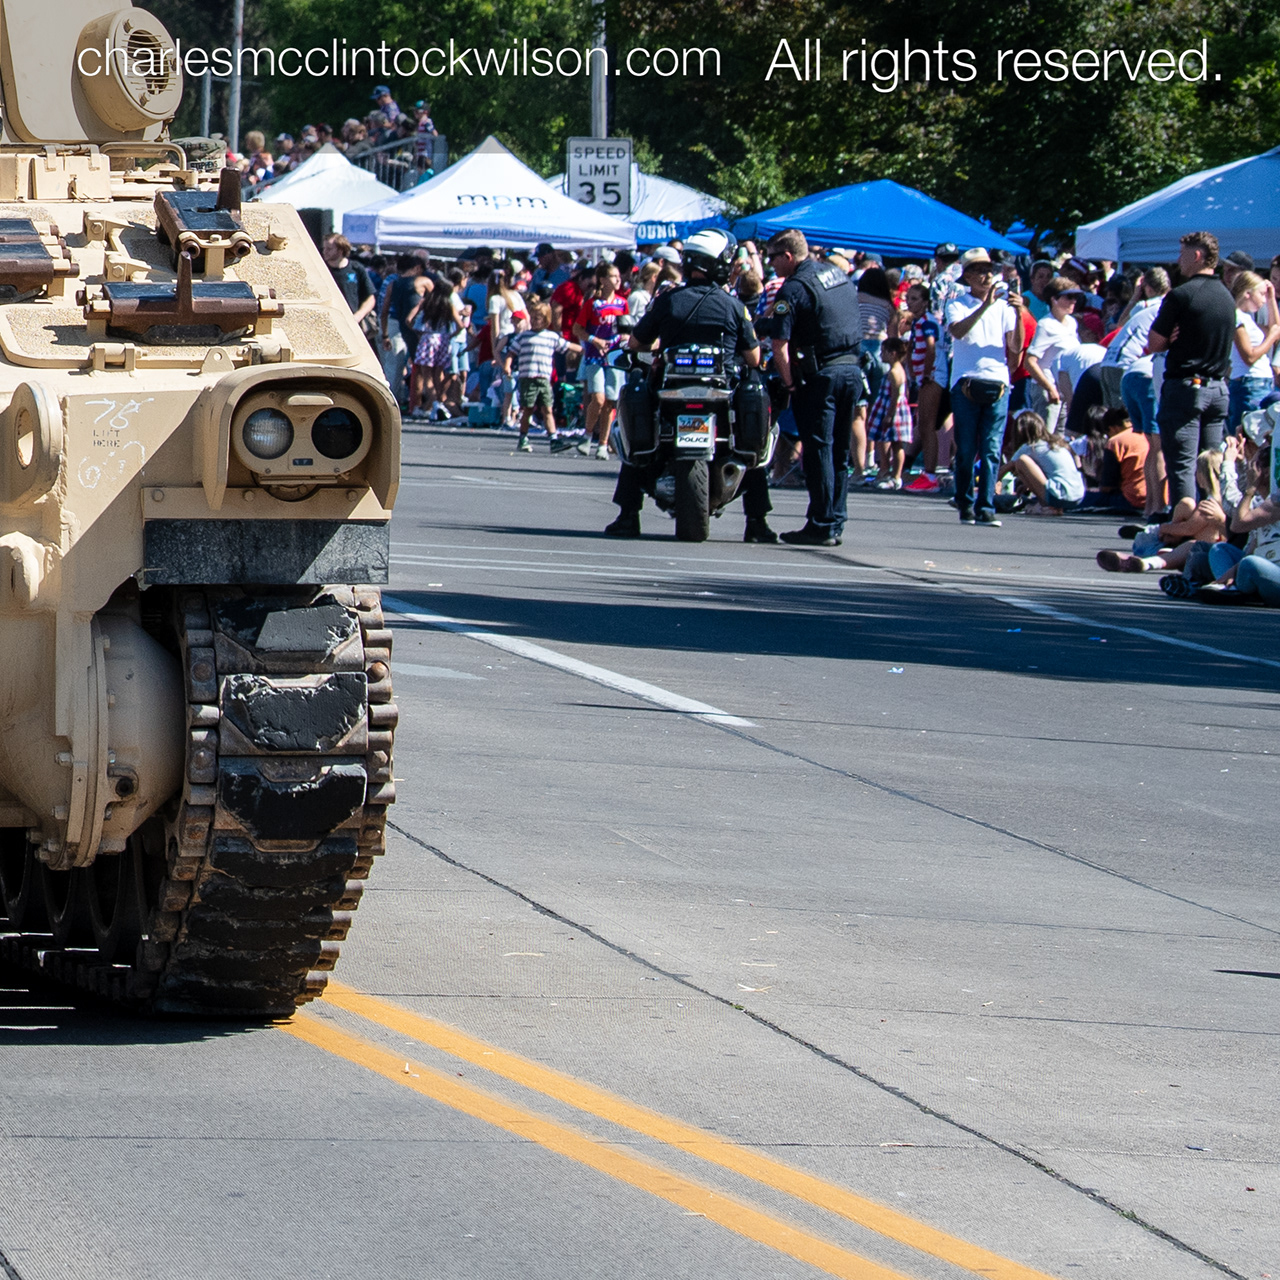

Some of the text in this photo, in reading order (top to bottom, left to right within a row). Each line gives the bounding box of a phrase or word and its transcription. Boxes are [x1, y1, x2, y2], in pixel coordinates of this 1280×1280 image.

[574, 147, 626, 159] SPEED
[579, 164, 619, 176] LIMIT
[579, 182, 621, 206] 35
[456, 194, 548, 210] mpm
